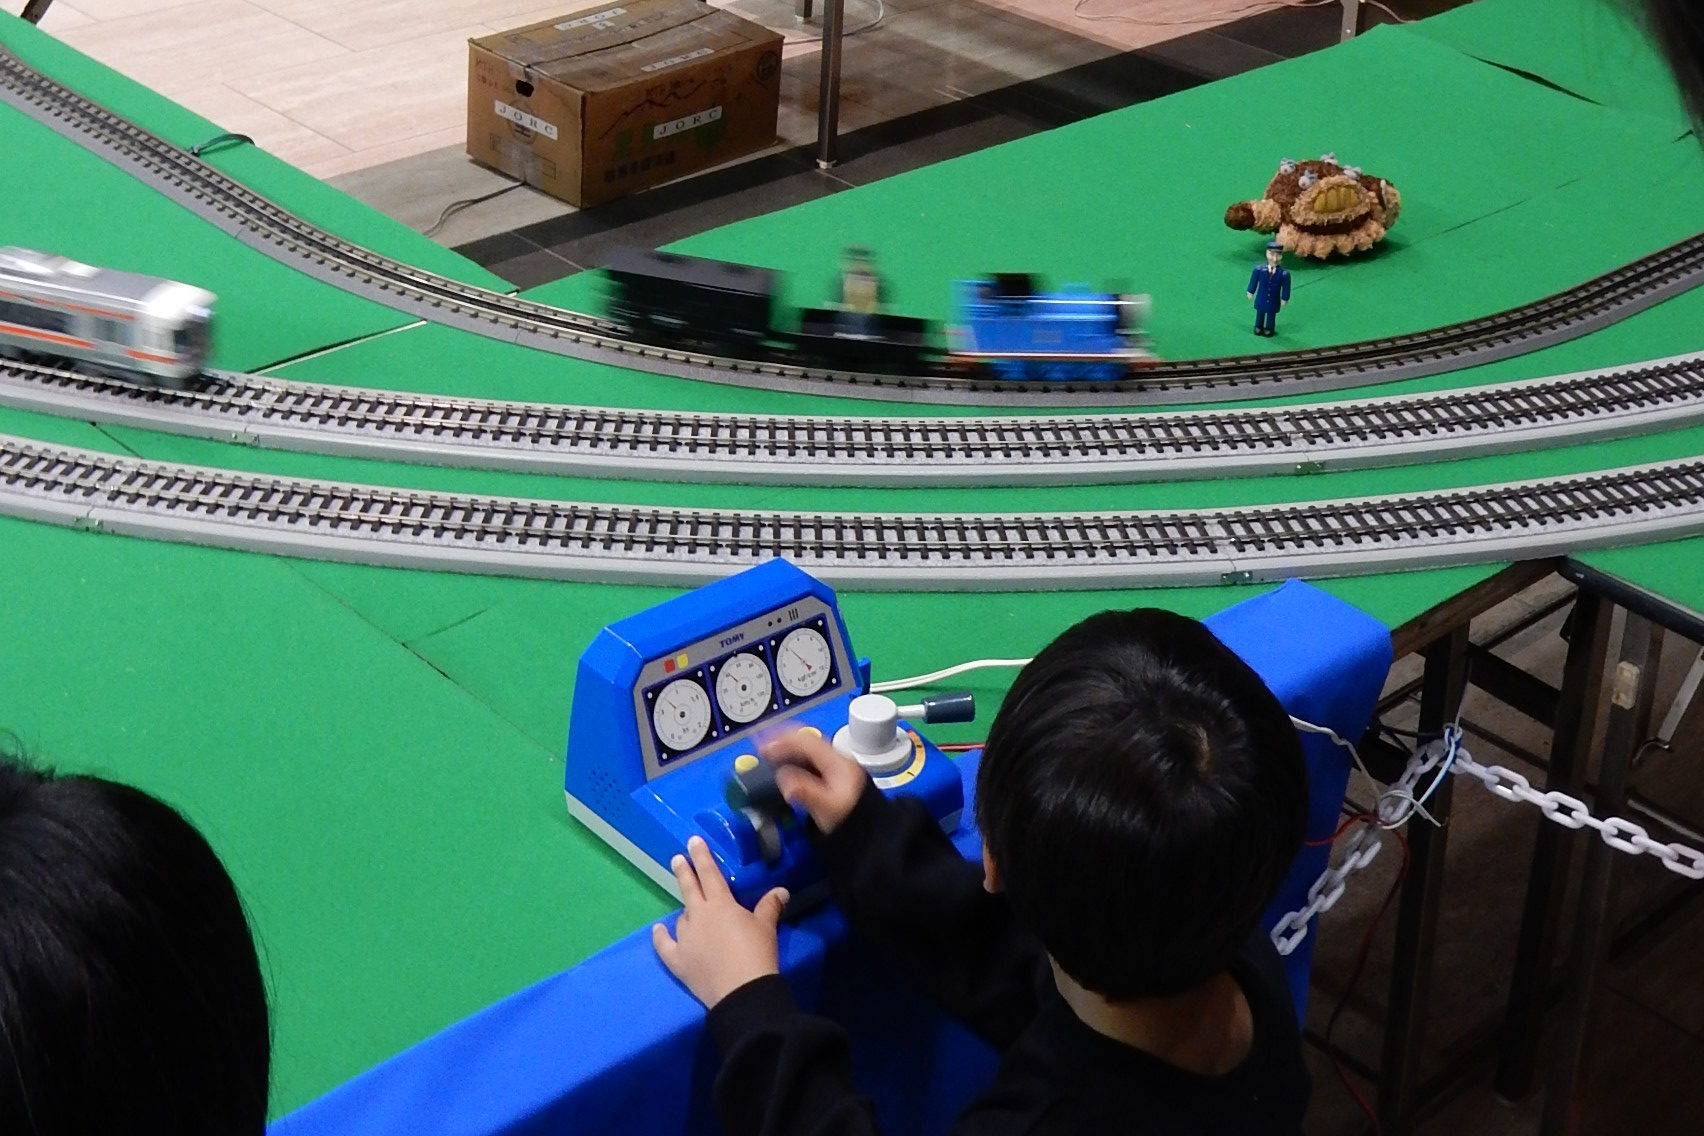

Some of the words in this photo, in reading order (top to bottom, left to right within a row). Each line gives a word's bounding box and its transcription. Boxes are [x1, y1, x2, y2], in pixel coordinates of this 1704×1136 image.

[499, 106, 554, 136] JORC
[658, 109, 718, 135] JORC
[718, 632, 745, 649] TOMY
